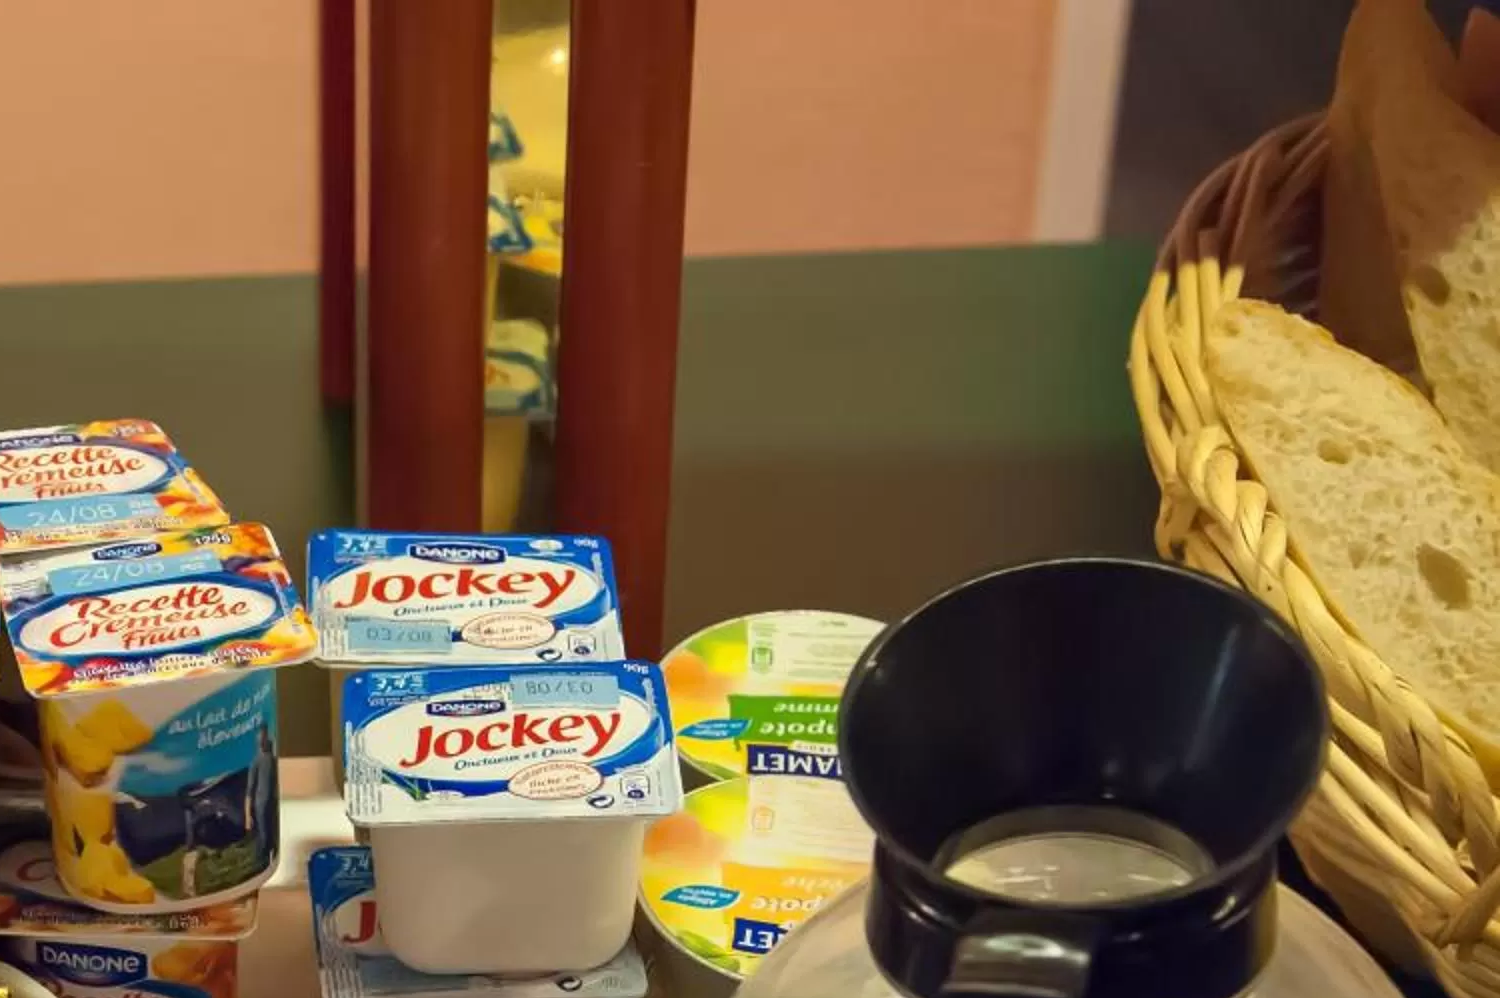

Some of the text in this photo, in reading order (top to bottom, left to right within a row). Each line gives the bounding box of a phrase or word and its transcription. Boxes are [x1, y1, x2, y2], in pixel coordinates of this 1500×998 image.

[27, 503, 117, 527] 24/08
[415, 545, 500, 561] DANONE
[72, 559, 165, 587] 24/08
[67, 585, 224, 620] Recette
[334, 568, 576, 609] Jockey
[122, 625, 202, 649] Fruits
[431, 701, 503, 714] DANONE
[400, 712, 621, 769] Jockey
[43, 946, 140, 974] DANONE
